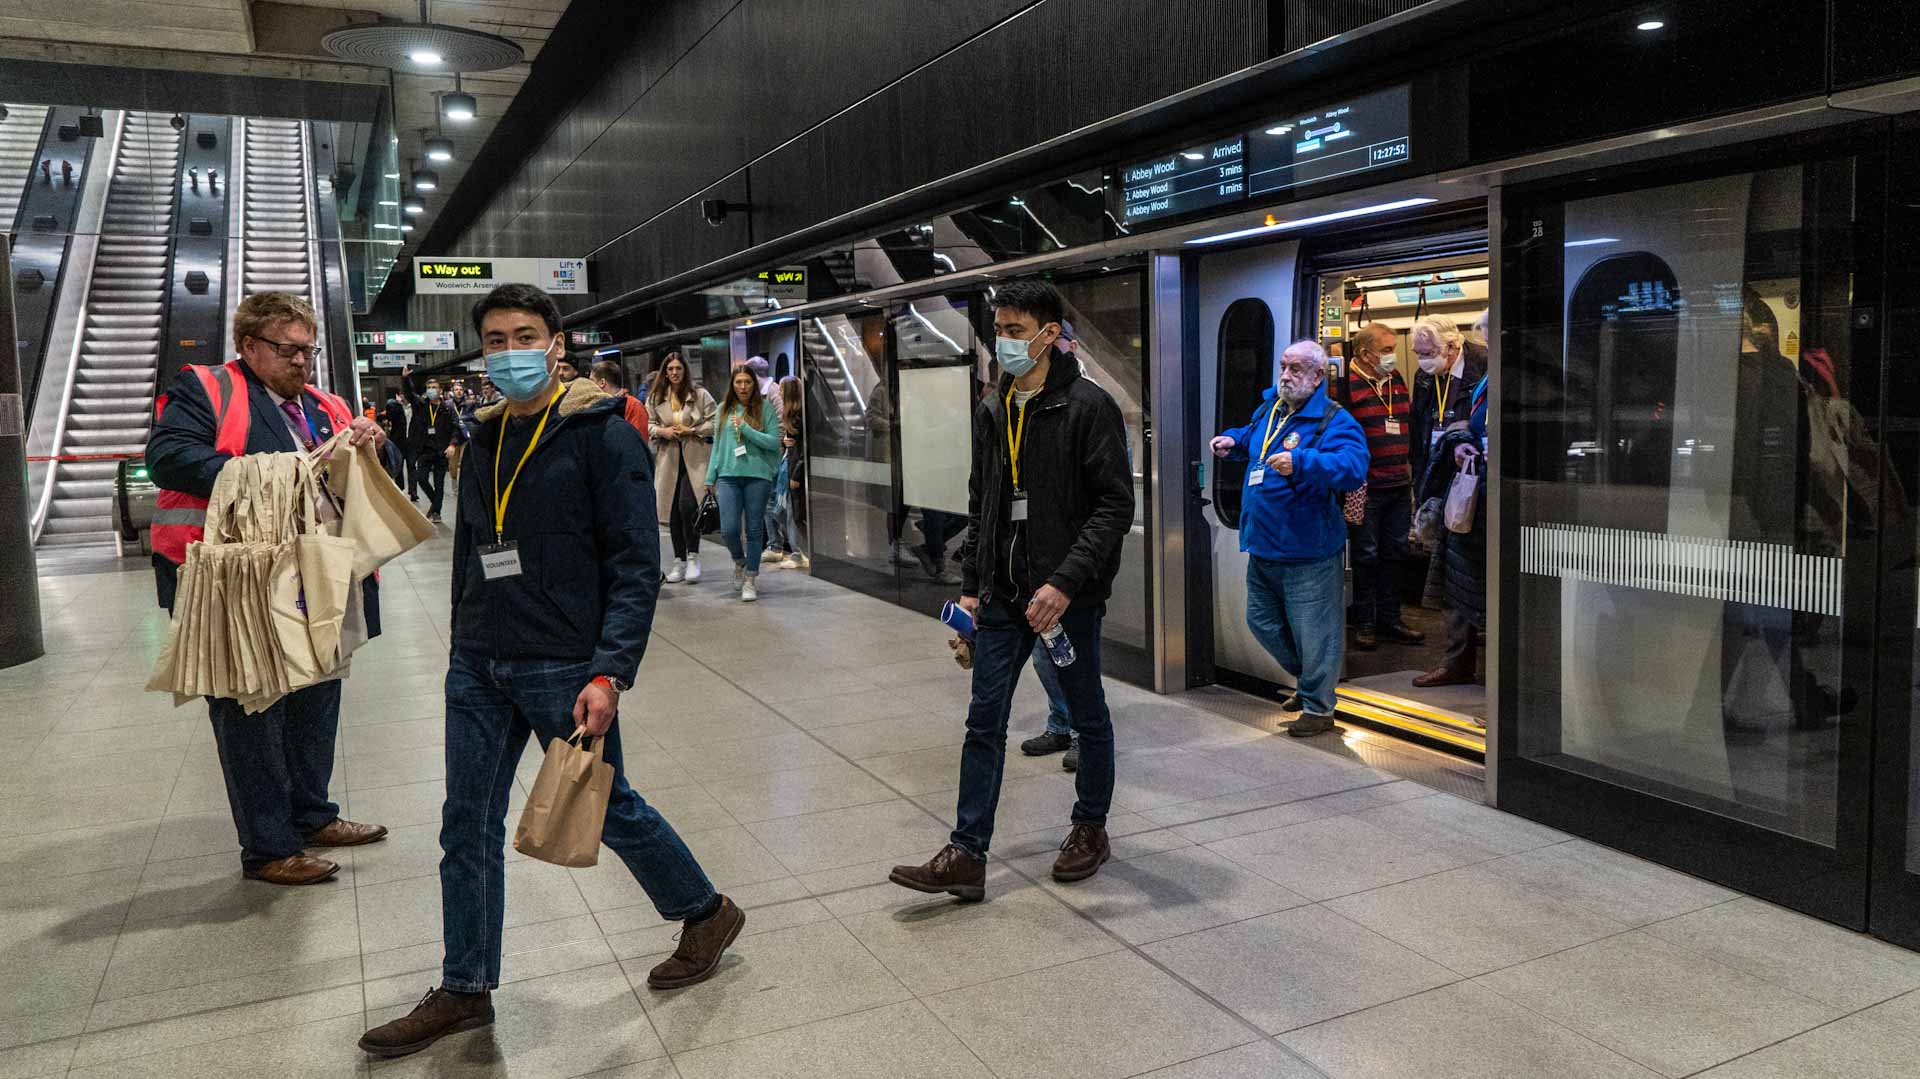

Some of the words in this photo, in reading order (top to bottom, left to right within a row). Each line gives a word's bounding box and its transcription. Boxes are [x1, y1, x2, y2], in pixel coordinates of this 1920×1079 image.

[1374, 144, 1405, 160] 12:27:52
[1131, 167, 1152, 181] Abbey
[1153, 159, 1175, 174] Wood
[1212, 140, 1241, 159] Arrived
[1125, 192, 1130, 201] 2.
[1131, 187, 1150, 200] Abbey
[1150, 182, 1168, 194] Wood
[1220, 169, 1224, 177] 3
[1225, 164, 1242, 176] mins
[1126, 208, 1131, 217] 4.
[1132, 203, 1150, 216] Abbey
[1150, 199, 1168, 211] Wood
[1220, 187, 1224, 195] 8
[1225, 183, 1242, 193] mins
[1532, 227, 1543, 238] 28
[433, 264, 458, 276] Way
[460, 265, 481, 275] out
[559, 261, 575, 269] Lift
